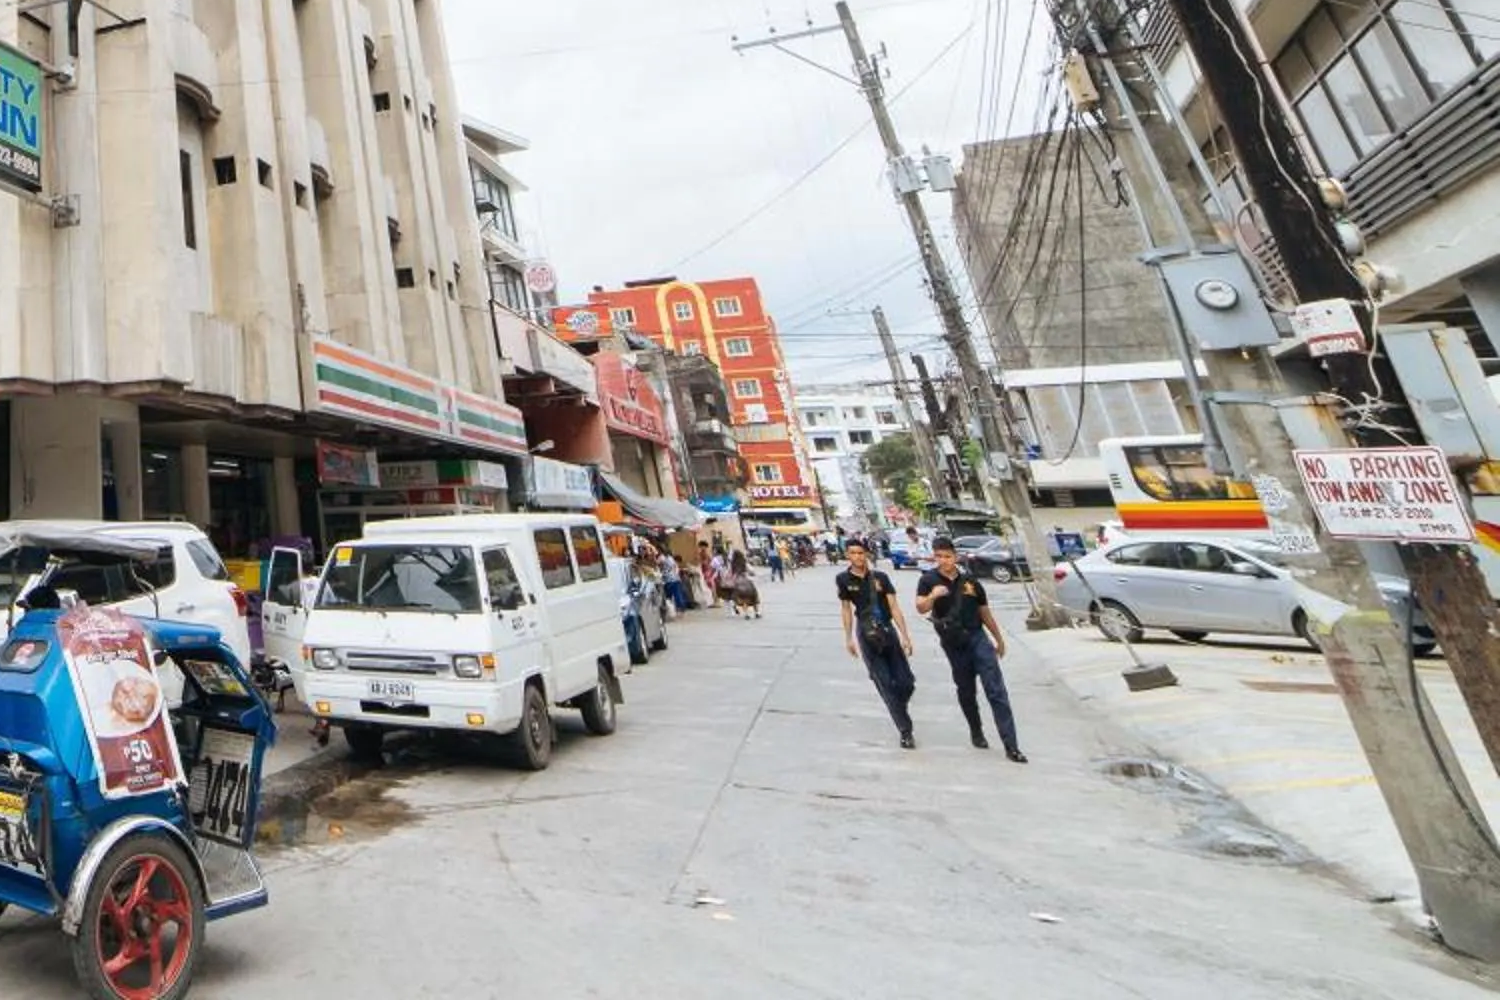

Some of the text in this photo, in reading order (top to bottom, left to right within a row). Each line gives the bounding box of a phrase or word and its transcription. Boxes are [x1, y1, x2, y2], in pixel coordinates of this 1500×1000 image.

[1302, 455, 1442, 480] NO PARKING
[1309, 481, 1346, 502] TOW
[1402, 480, 1454, 504] ZONE
